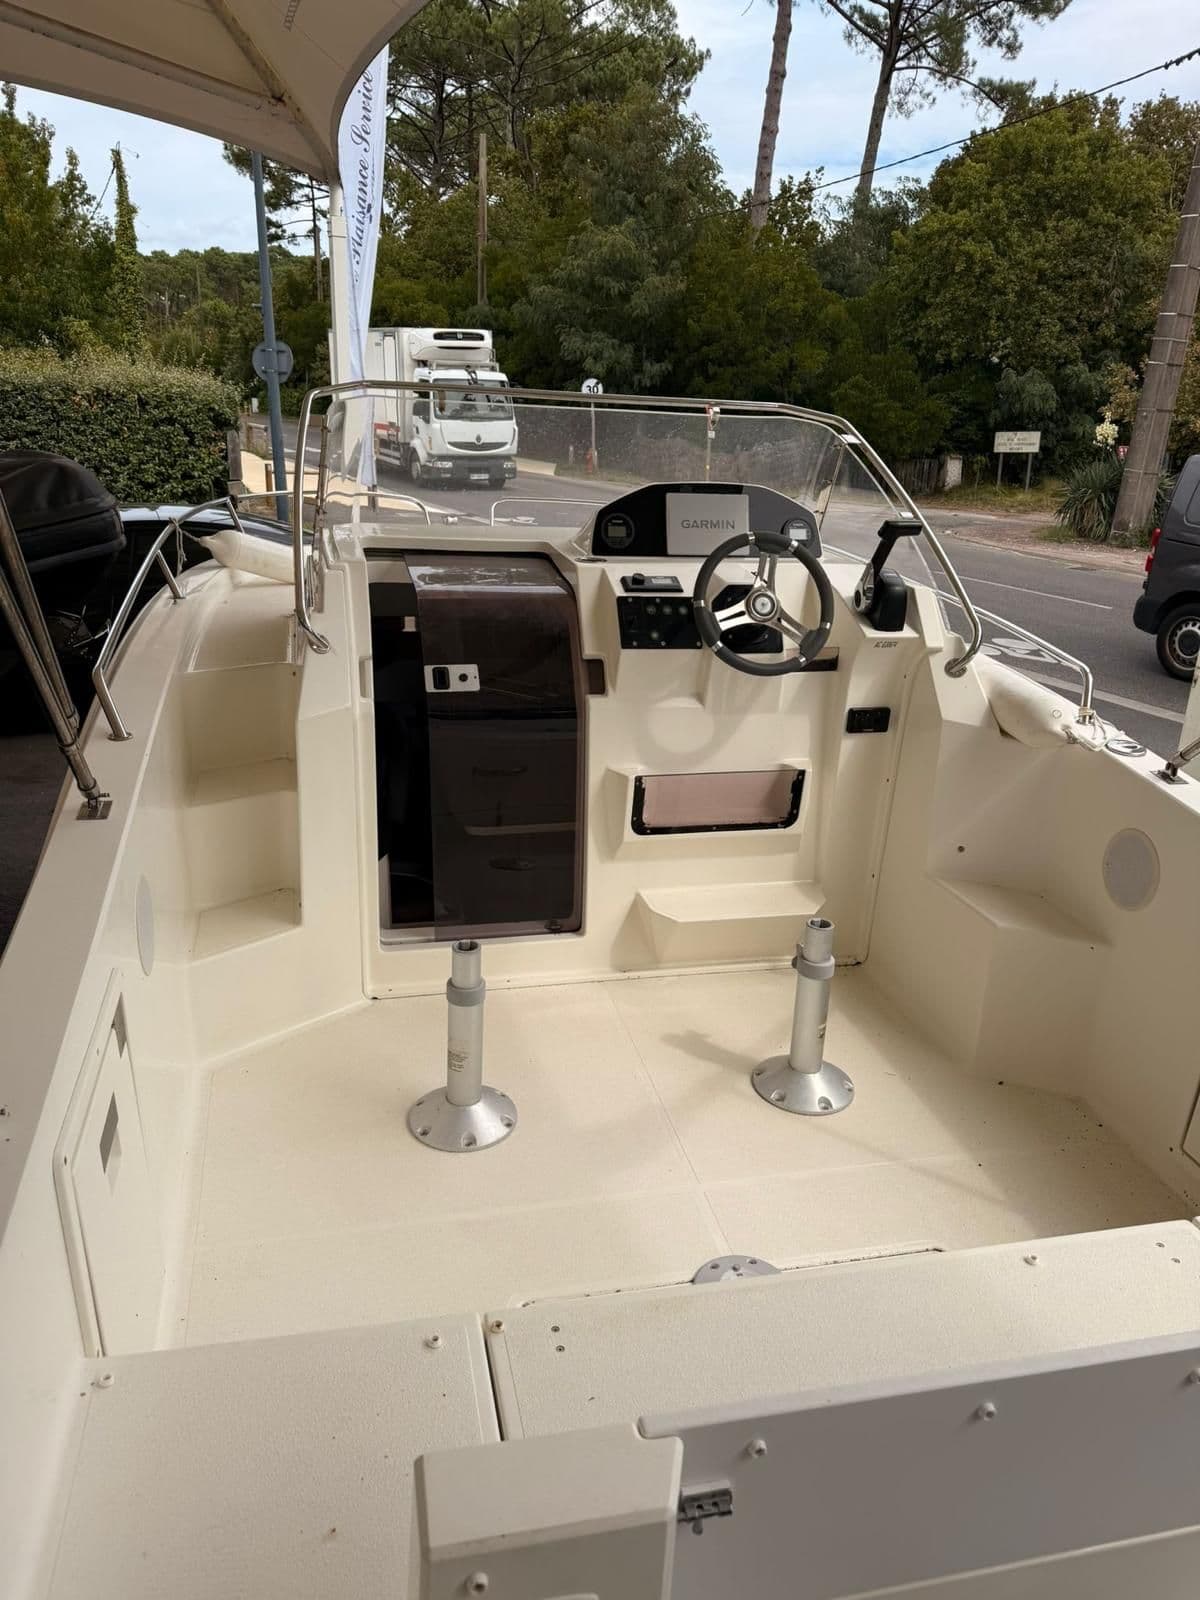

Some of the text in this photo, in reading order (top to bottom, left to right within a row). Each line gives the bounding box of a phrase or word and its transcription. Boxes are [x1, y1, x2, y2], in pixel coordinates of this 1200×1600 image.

[350, 70, 373, 153] Service
[586, 385, 599, 394] 30
[680, 519, 735, 529] GARMIN
